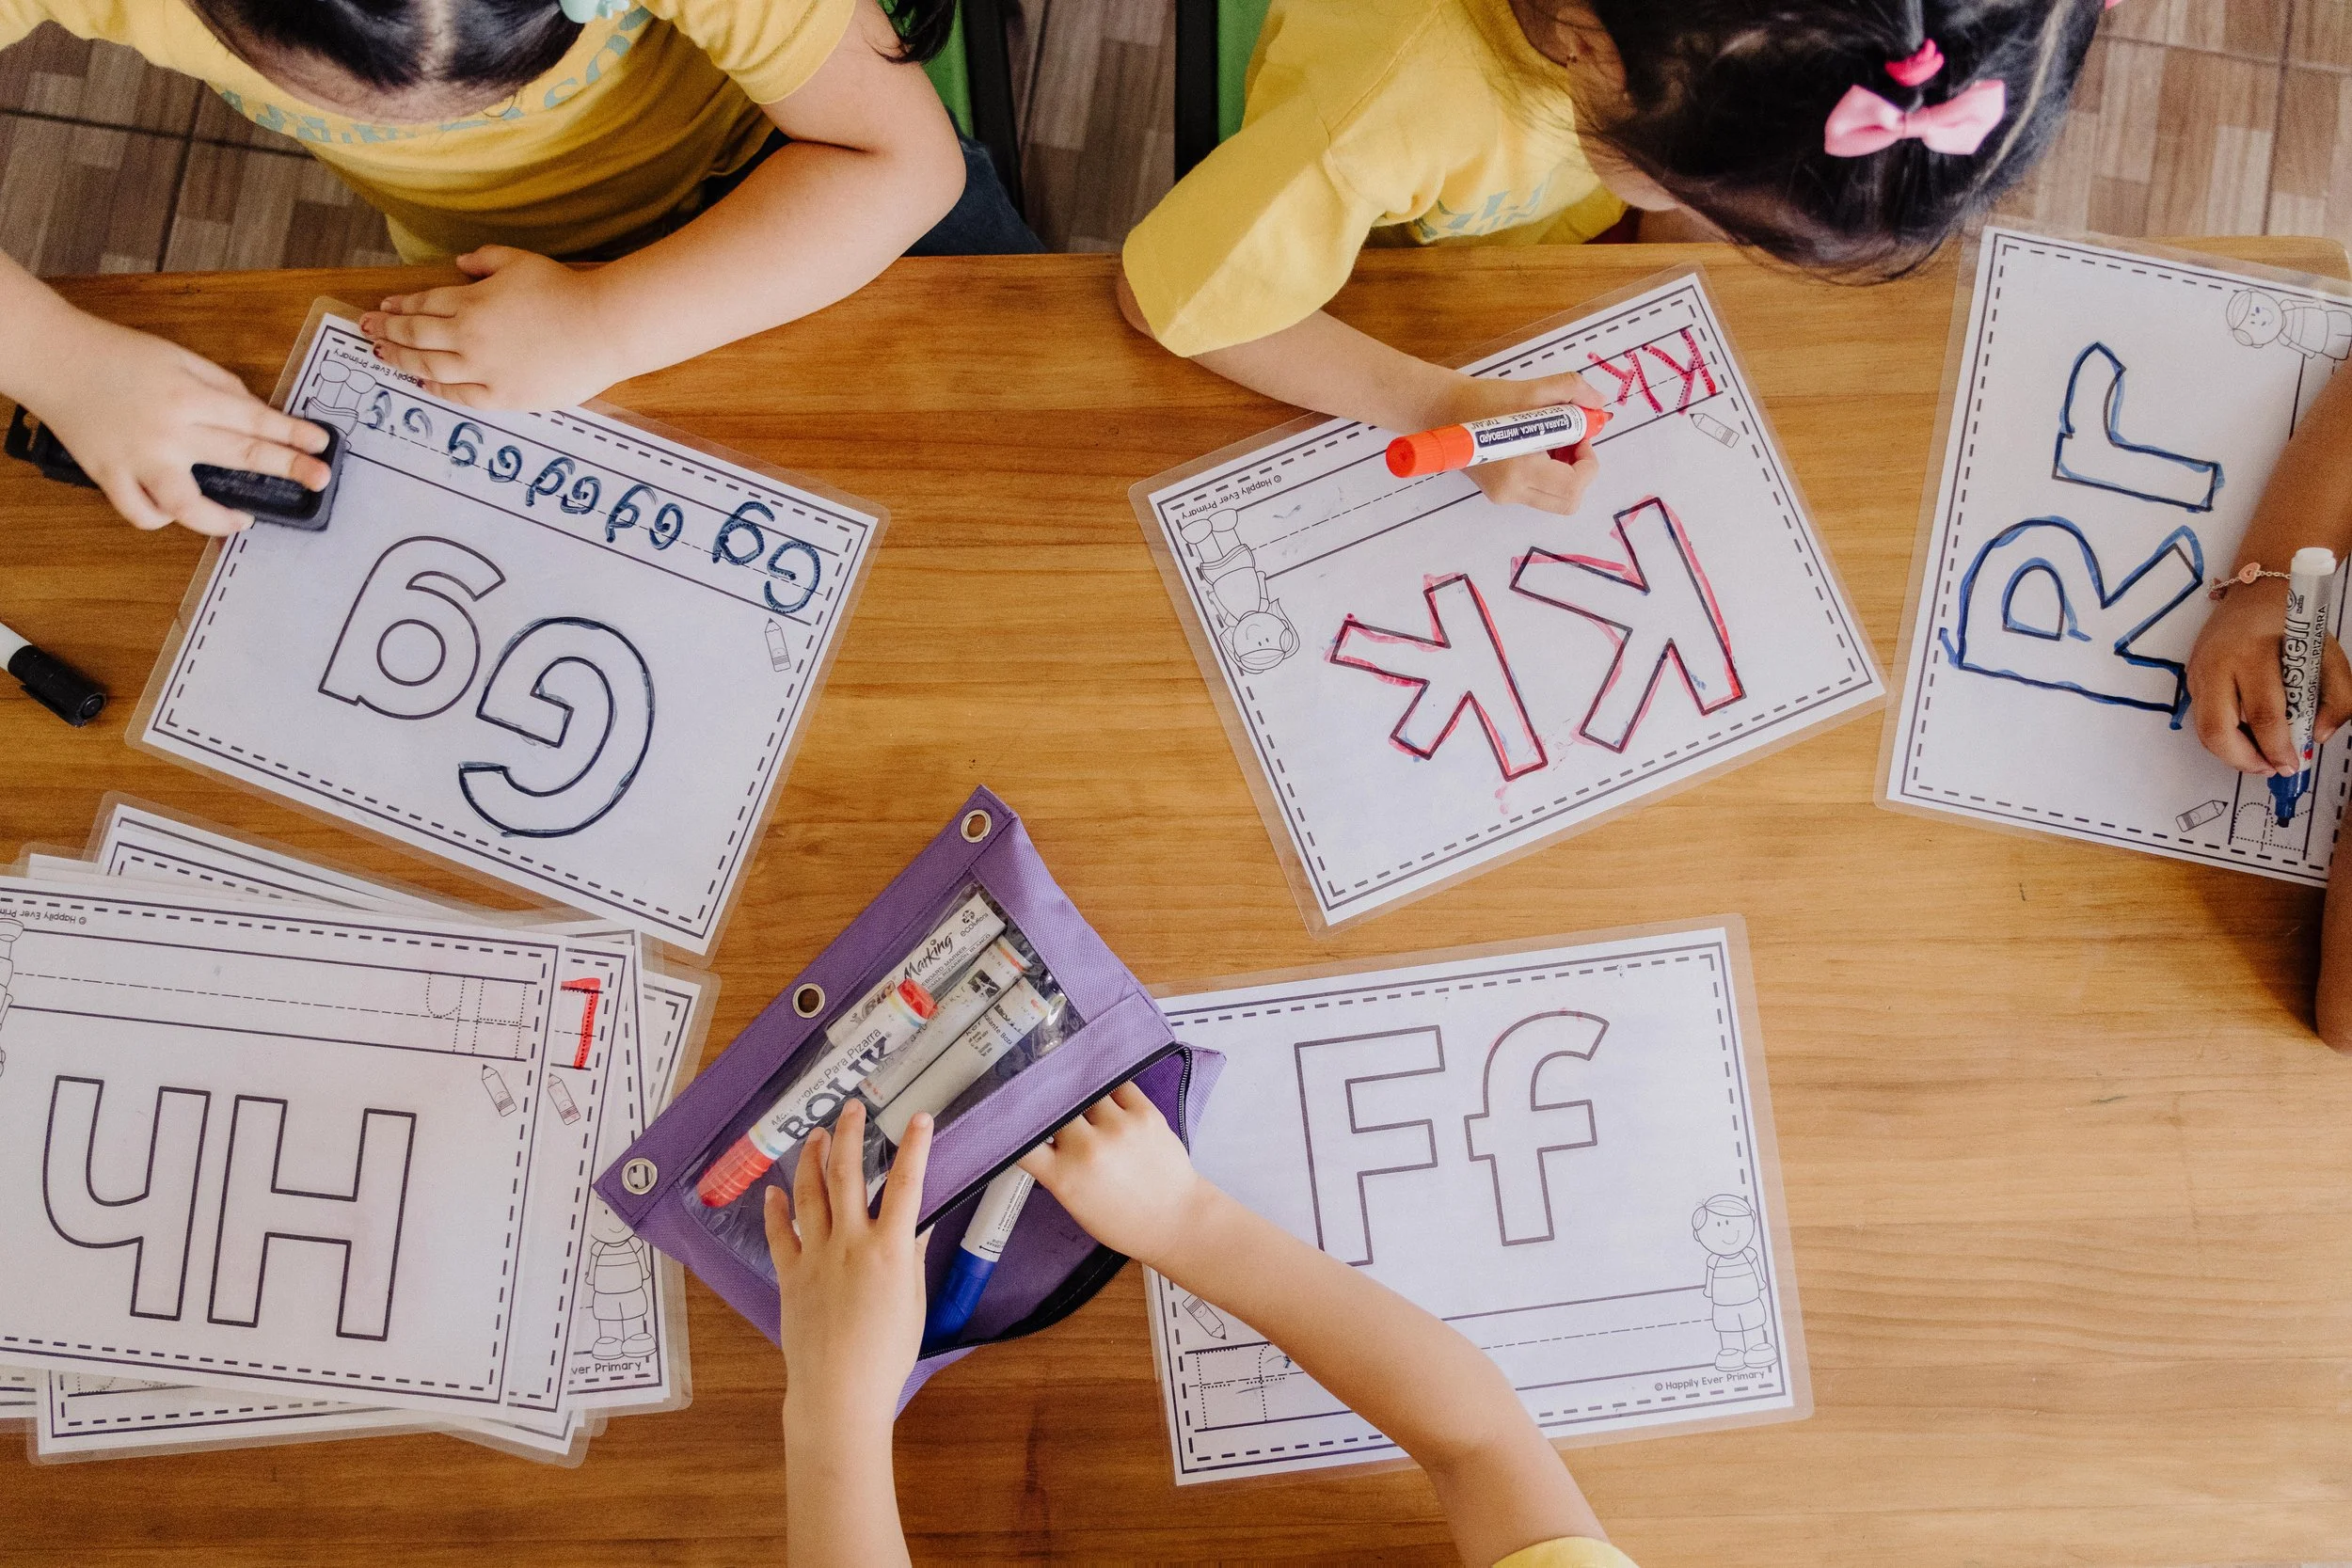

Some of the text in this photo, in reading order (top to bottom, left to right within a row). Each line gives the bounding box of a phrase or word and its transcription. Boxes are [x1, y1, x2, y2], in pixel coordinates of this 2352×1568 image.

[331, 347, 421, 386] appily Ever Primary
[1479, 427, 1518, 443] WHITEBOARD
[1519, 422, 1544, 436] BLANCA
[1544, 417, 1568, 431] PIZARRA
[1217, 491, 1239, 504] Ever
[1240, 477, 1272, 496] Happily
[1180, 500, 1217, 519] Primary
[1942, 341, 2225, 728] Rr
[1324, 497, 1747, 783] Kk
[2312, 605, 2327, 656] PIZARRA
[320, 536, 656, 836] Gg
[19, 910, 40, 919] Ever
[43, 911, 75, 923] Happily
[905, 931, 954, 977] Marking
[968, 931, 991, 954] BLANCO
[943, 944, 967, 968] MARKER
[822, 1055, 848, 1080] Para
[846, 1025, 882, 1059] Pizarra
[1295, 1009, 1611, 1266] Ff
[42, 1075, 417, 1342] Hh
[571, 1360, 641, 1374] ver Primary
[1665, 1378, 1698, 1390] Happily
[1701, 1374, 1723, 1385] Ever
[1726, 1369, 1764, 1383] Primary
